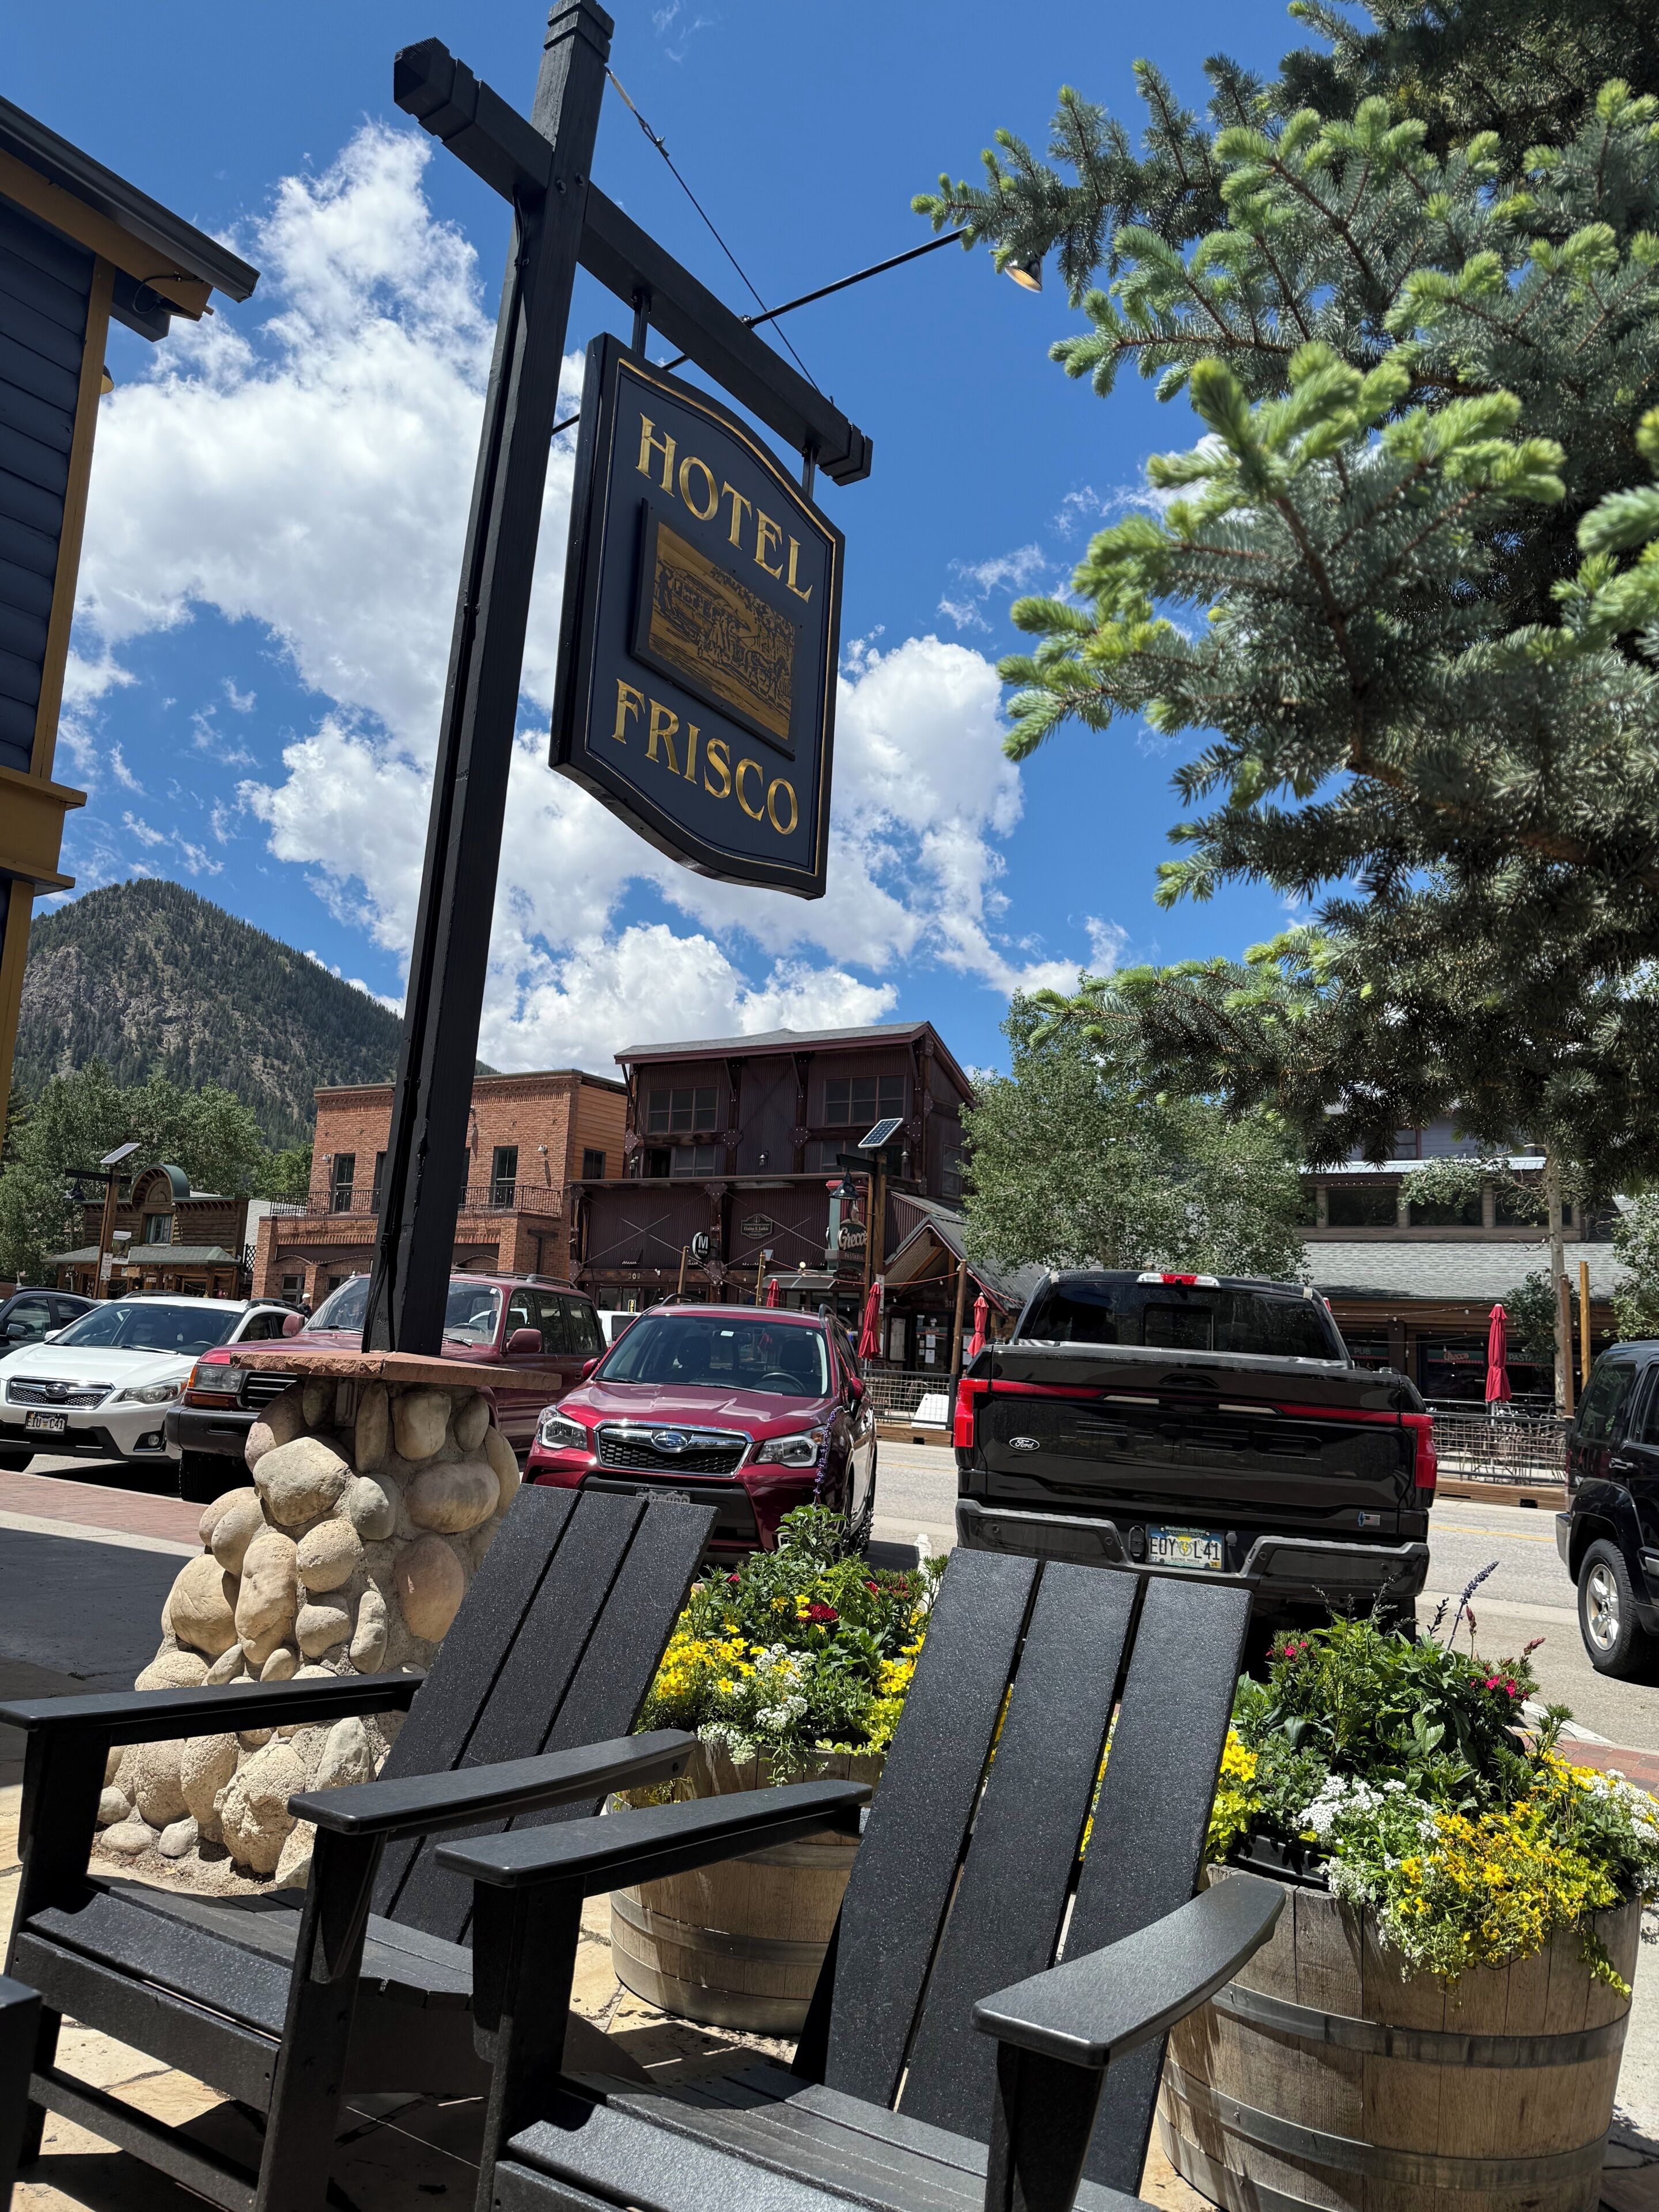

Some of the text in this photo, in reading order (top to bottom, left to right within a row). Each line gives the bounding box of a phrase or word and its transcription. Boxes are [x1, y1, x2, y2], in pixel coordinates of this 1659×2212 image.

[635, 412, 813, 603] HOTEL
[611, 678, 799, 835] FRISCO
[698, 1235, 709, 1249] M
[50, 1418, 63, 1429] C41
[1015, 1439, 1035, 1448] Ford
[1194, 1541, 1220, 1560] L41
